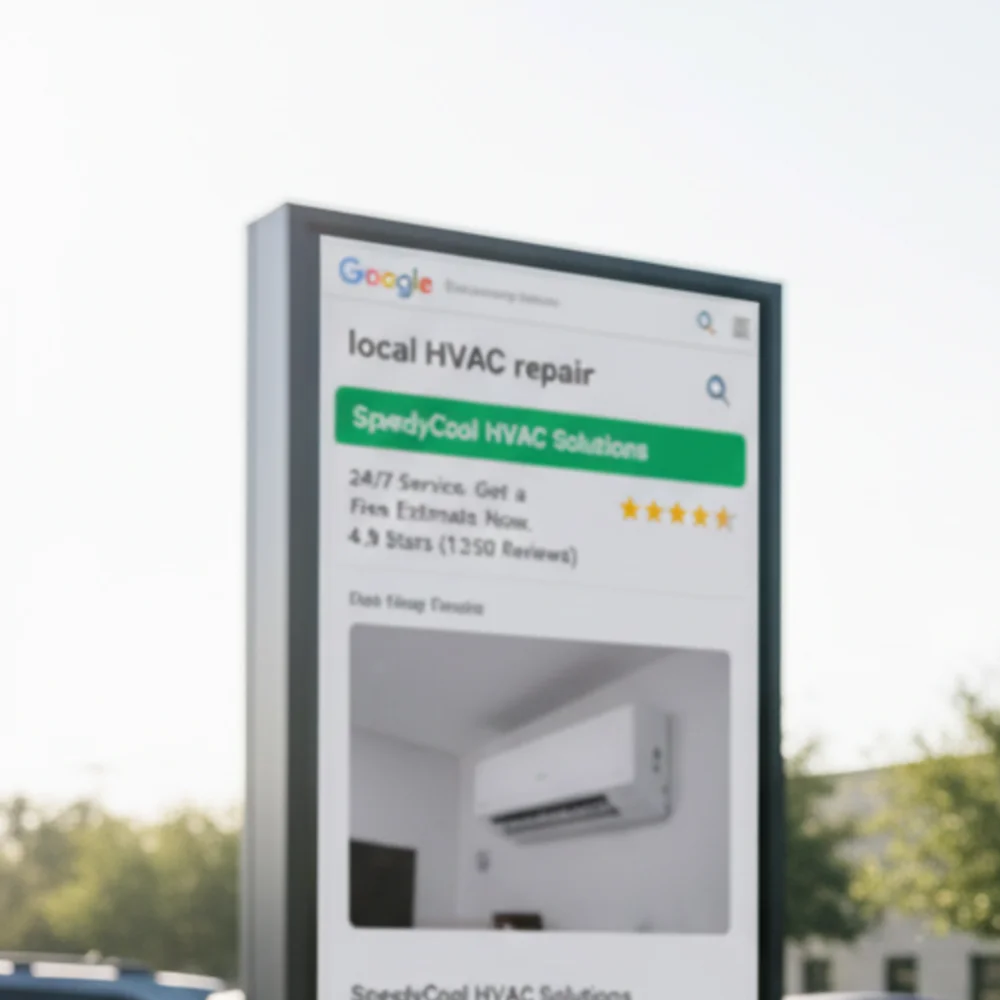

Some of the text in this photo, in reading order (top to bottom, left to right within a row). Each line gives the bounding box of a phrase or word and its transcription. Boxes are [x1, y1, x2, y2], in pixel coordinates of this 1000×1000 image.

[338, 256, 433, 298] Google
[349, 329, 596, 389] local HVAC repair
[485, 420, 547, 449] HVAC
[552, 429, 649, 461] Solutions
[349, 468, 393, 489] 24/7
[385, 529, 433, 552] Stars
